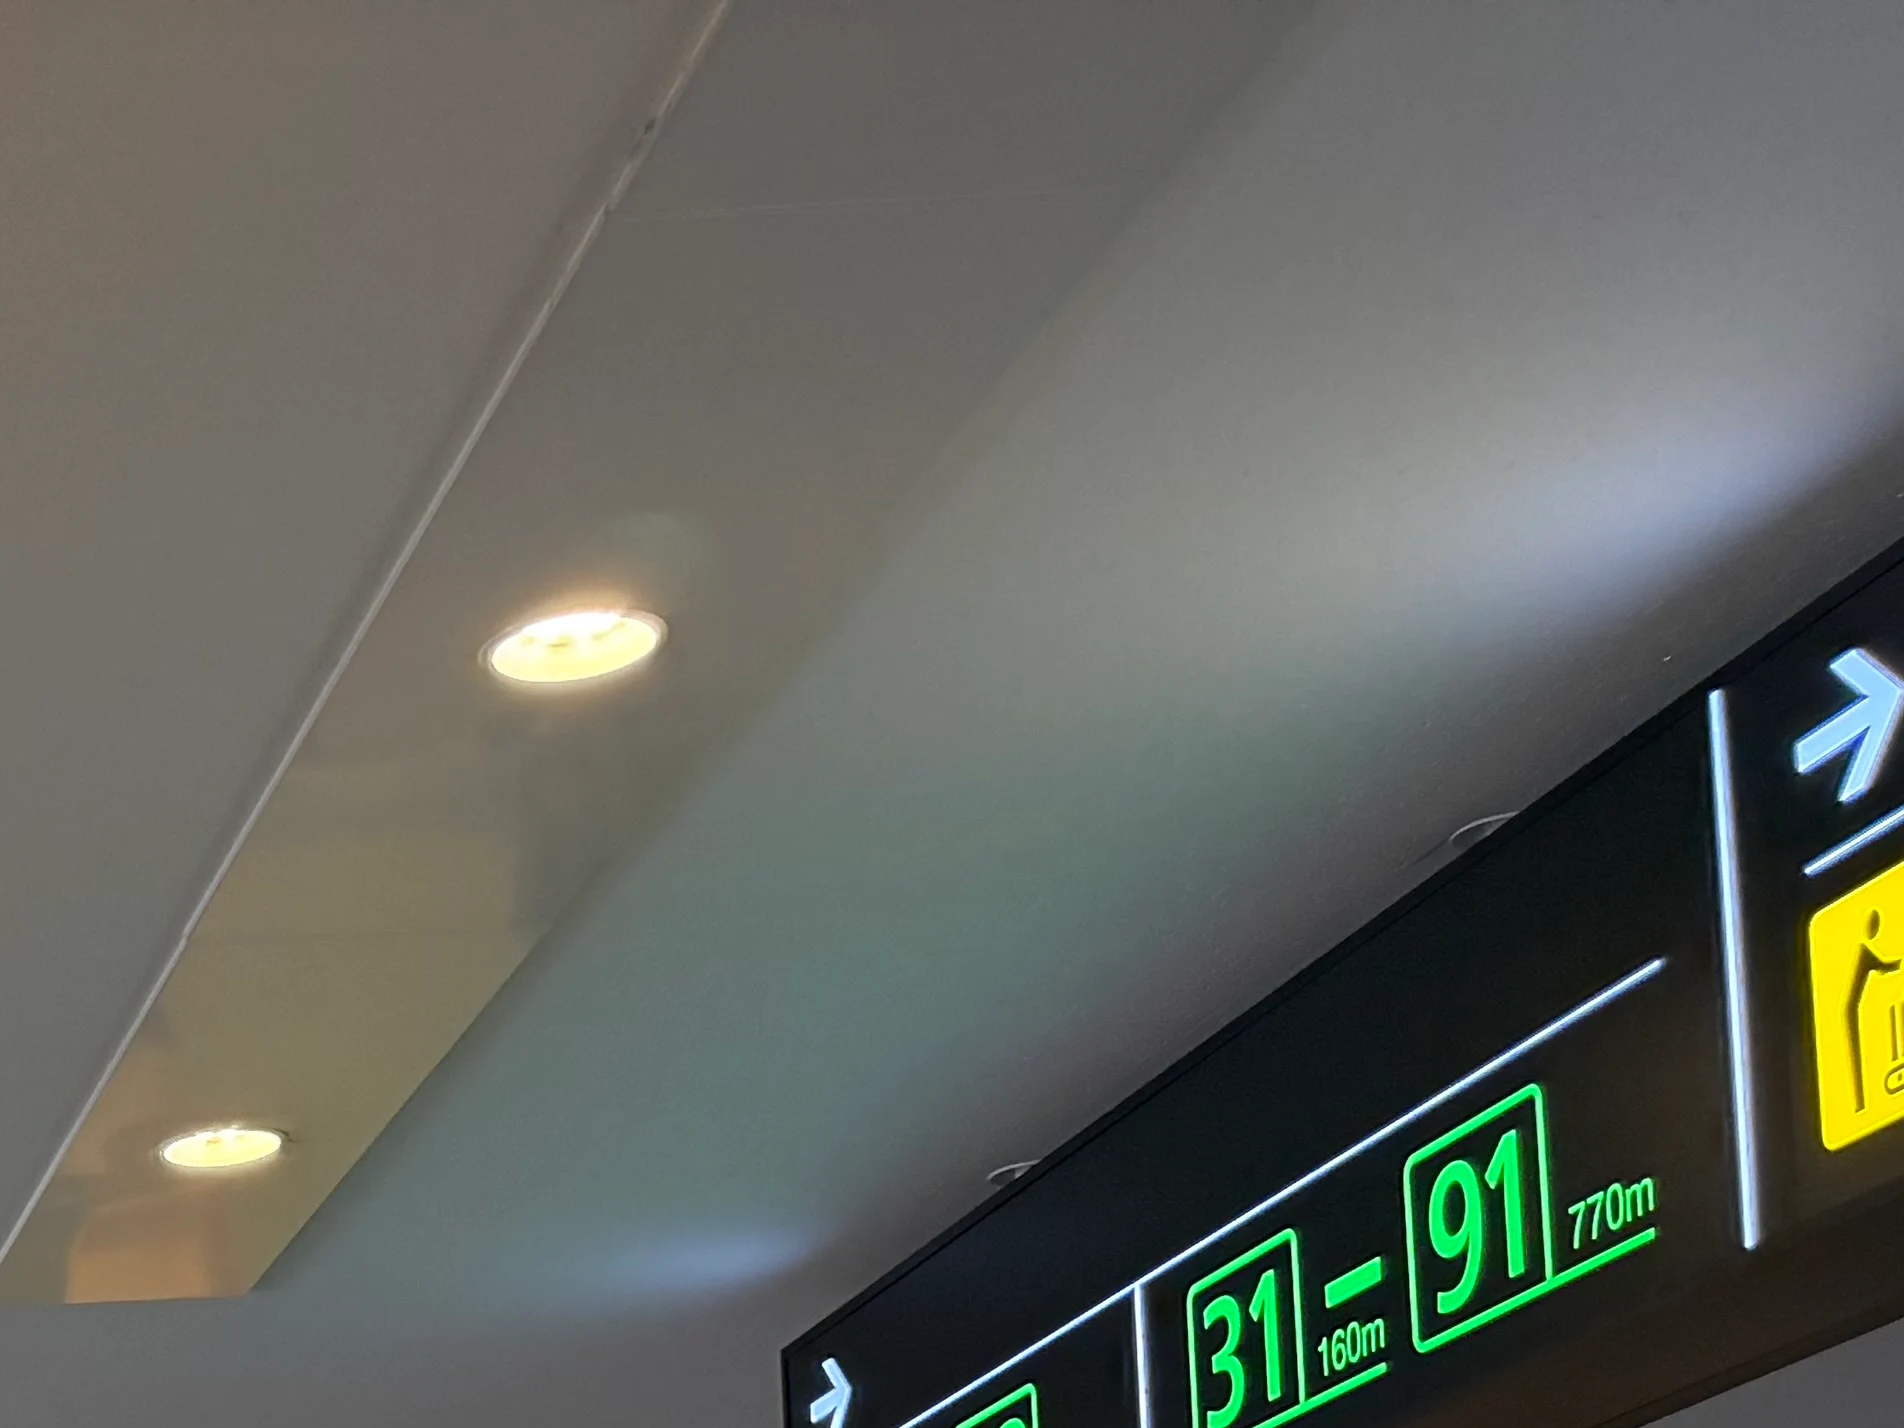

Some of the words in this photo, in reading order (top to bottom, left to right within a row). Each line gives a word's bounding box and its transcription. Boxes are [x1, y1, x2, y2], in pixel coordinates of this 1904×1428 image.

[1428, 1129, 1526, 1315] 91
[1568, 1177, 1657, 1250] 770m
[1317, 1318, 1386, 1377] 160m
